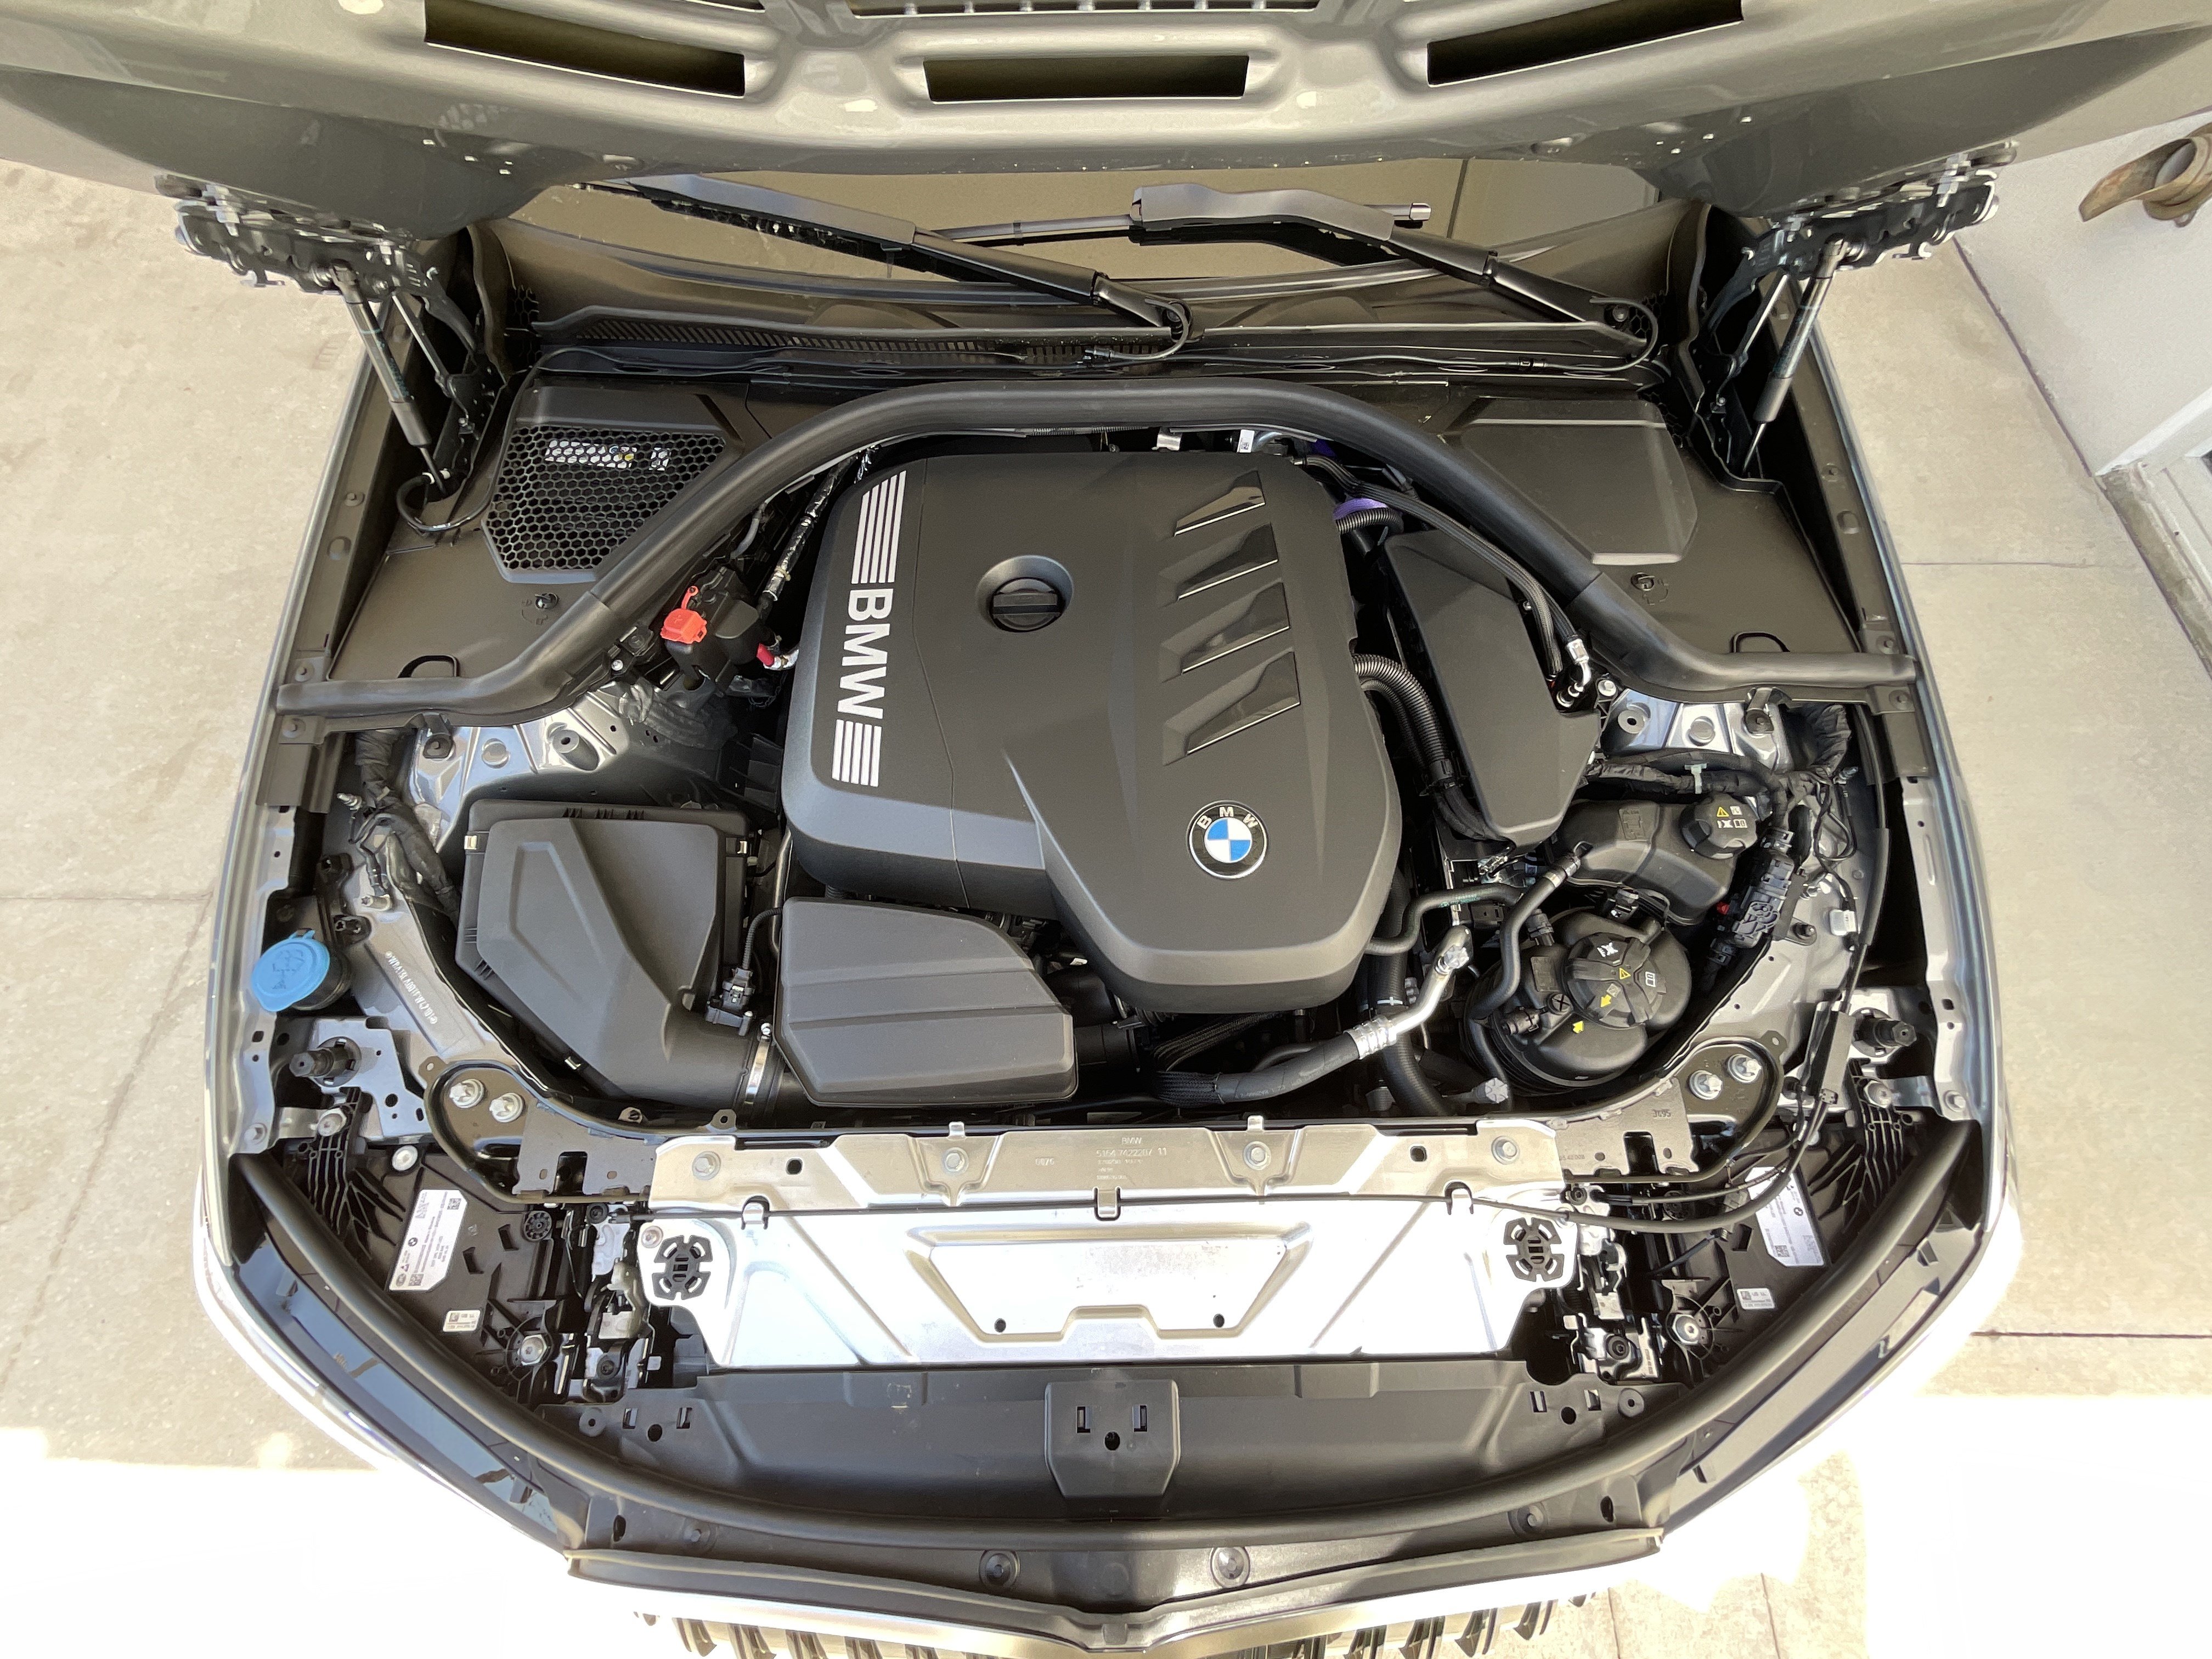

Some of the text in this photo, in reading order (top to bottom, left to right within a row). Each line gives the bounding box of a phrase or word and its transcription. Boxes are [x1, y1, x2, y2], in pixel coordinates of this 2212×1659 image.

[837, 588, 894, 719] BMW
[1197, 806, 1258, 830] BMW
[1121, 1137, 1142, 1145] BMW
